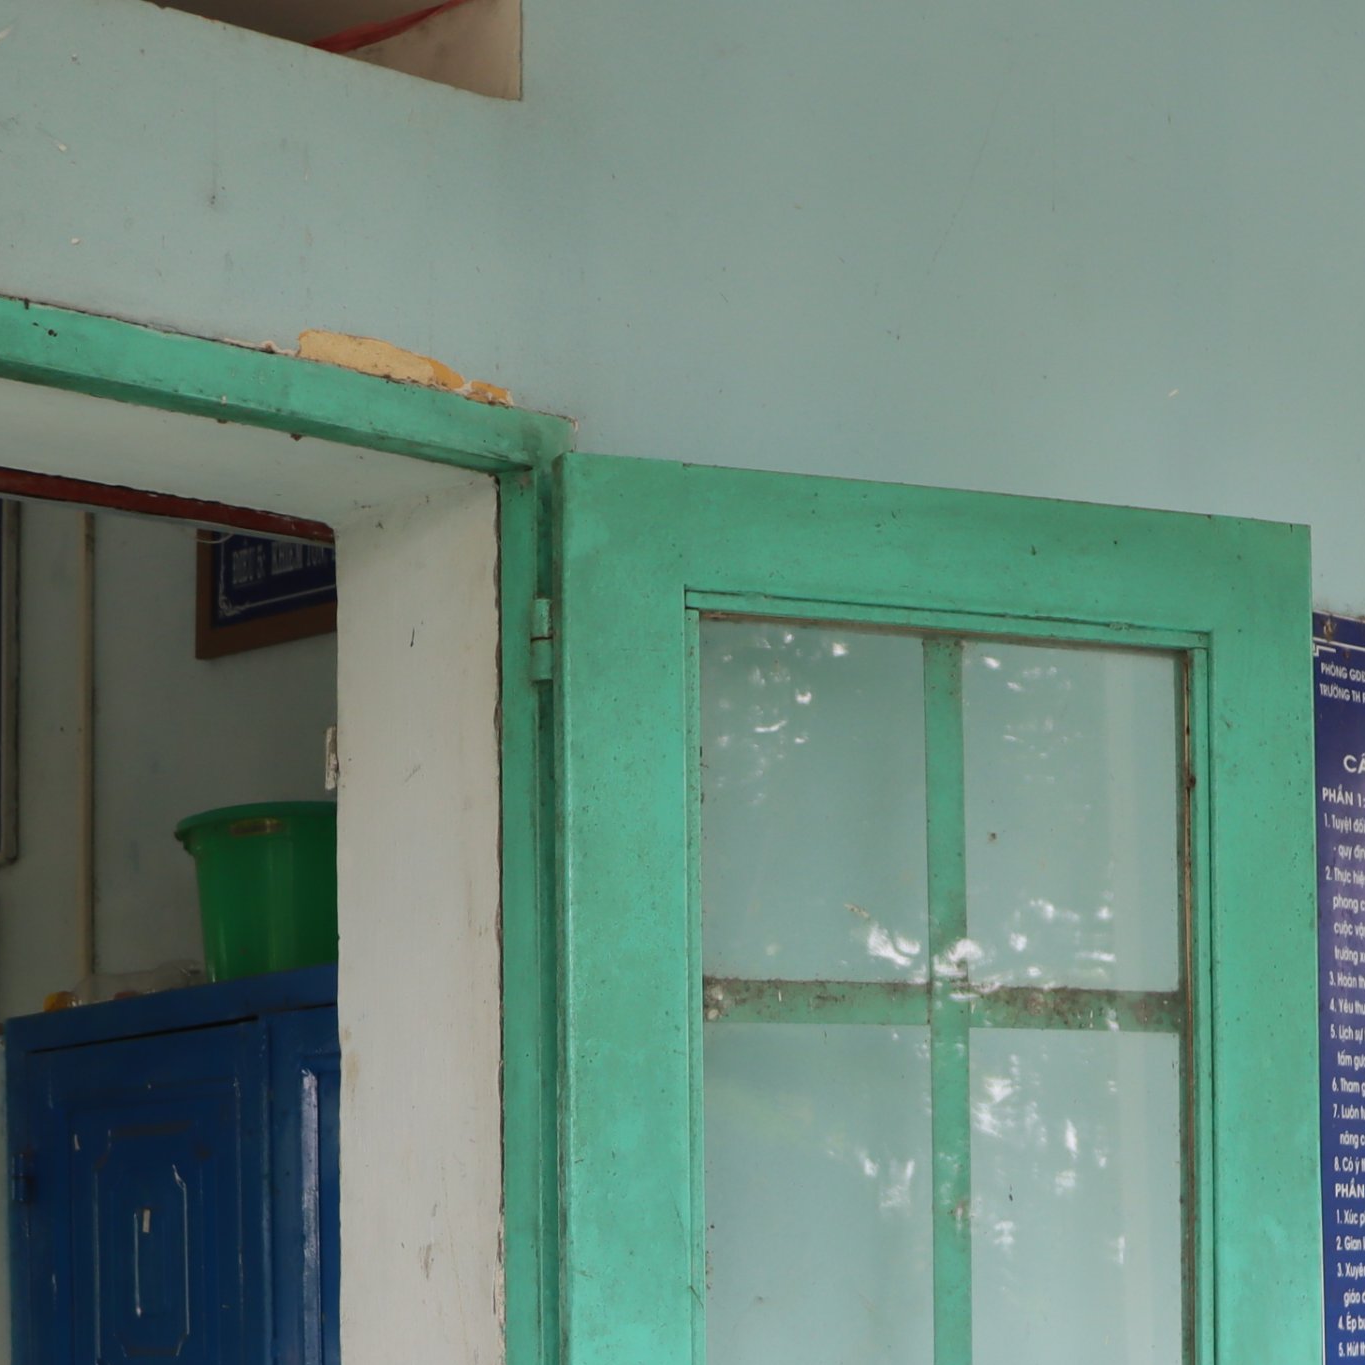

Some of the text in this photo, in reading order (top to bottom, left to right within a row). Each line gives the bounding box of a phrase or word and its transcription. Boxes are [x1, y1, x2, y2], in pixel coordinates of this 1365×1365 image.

[1322, 783, 1354, 806] PHẦN
[1357, 792, 1365, 808] 1:
[1335, 1177, 1365, 1199] PHẦN
